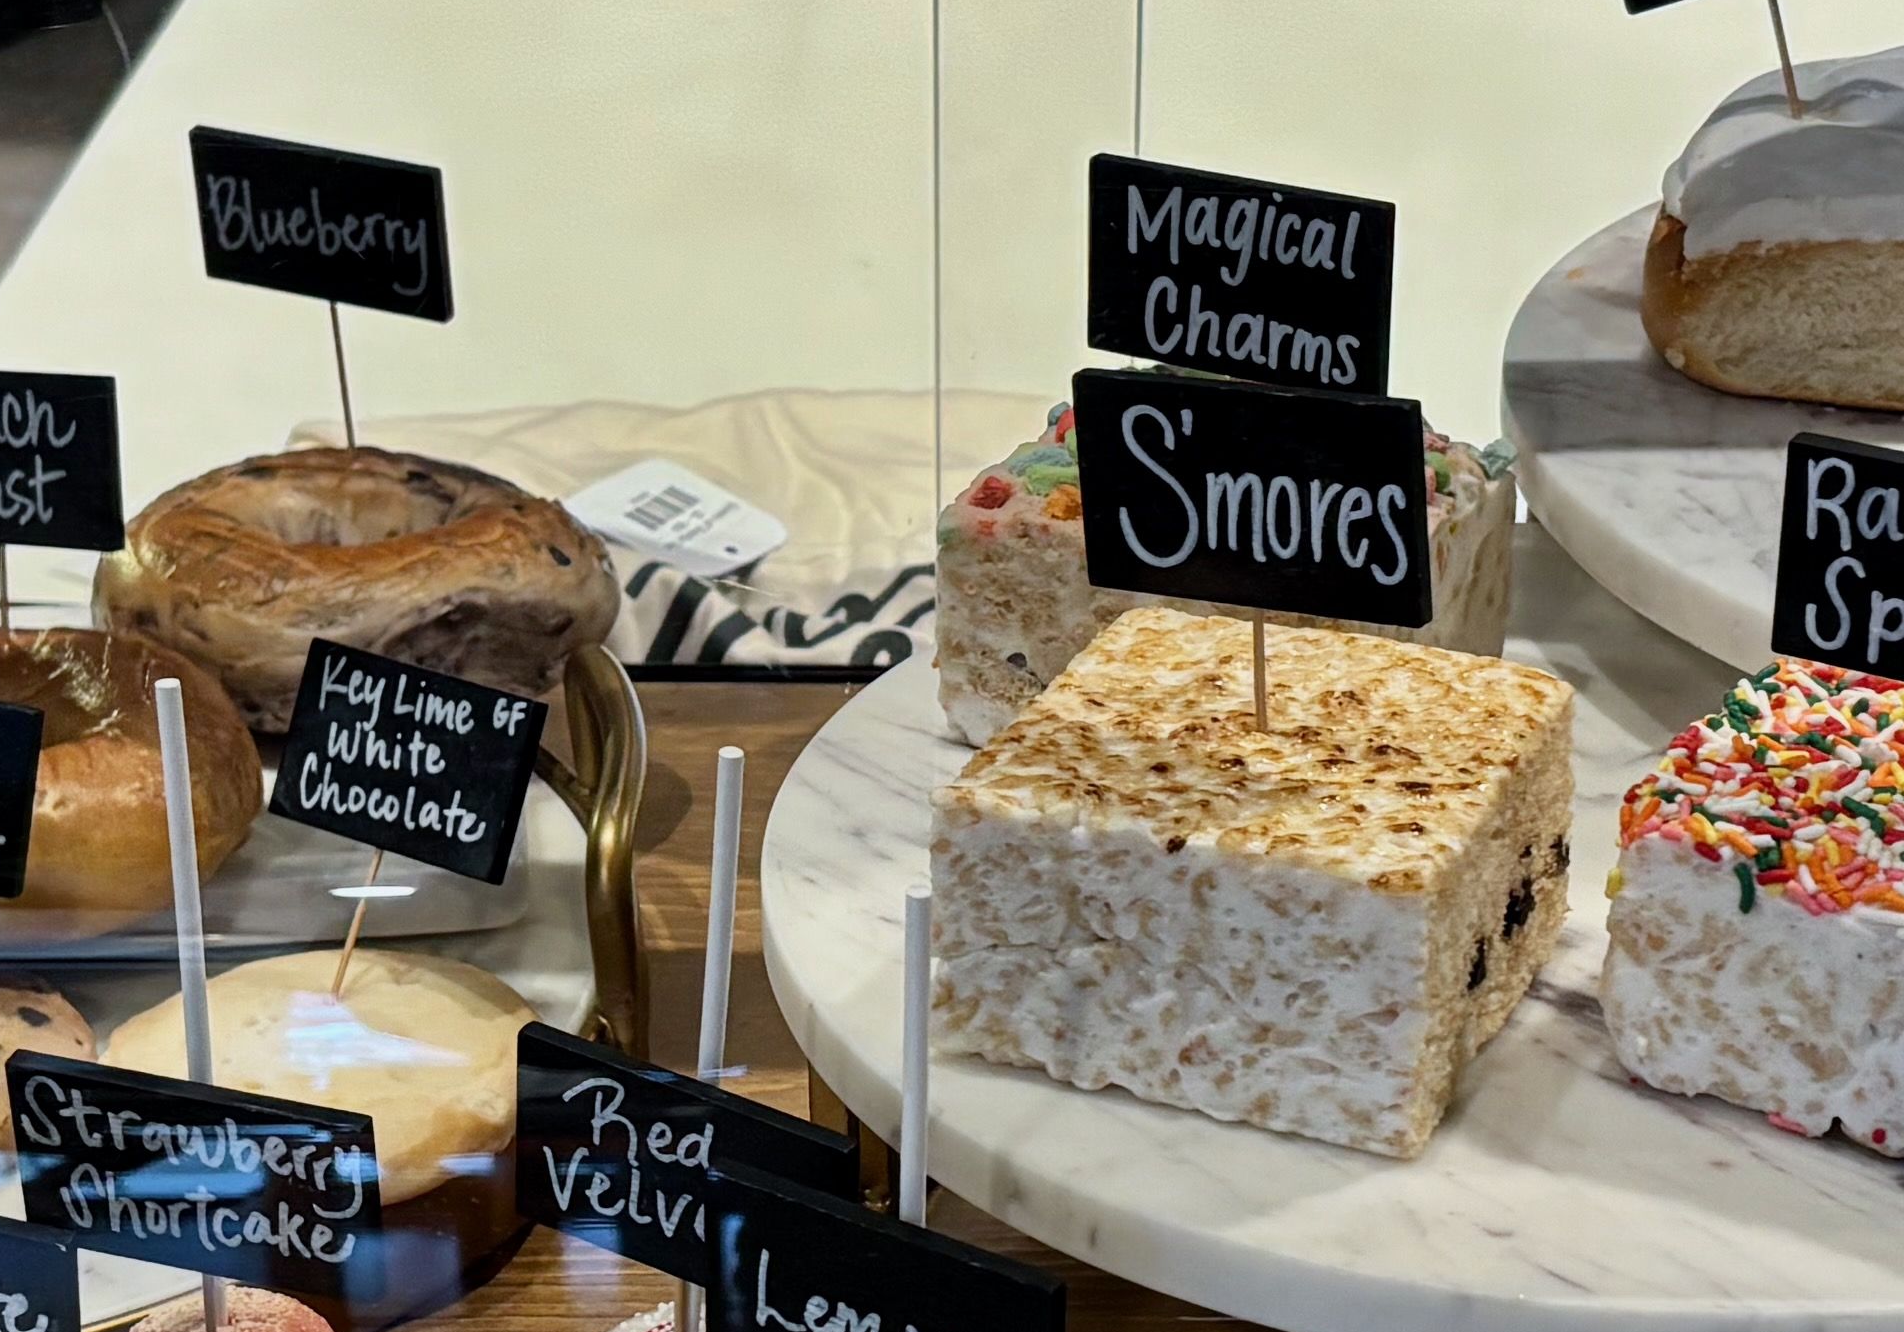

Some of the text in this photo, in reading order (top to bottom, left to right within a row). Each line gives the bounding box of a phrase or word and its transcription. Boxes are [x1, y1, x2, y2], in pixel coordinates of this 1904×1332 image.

[205, 172, 427, 296] Blueberry
[1127, 184, 1362, 287] Magical
[1144, 274, 1361, 386] Charms
[1118, 403, 1409, 586] S'mores
[319, 654, 528, 737] Key Lime GF
[298, 751, 487, 844] Chocolate
[328, 721, 446, 778] White
[18, 1075, 363, 1219] Strawberry
[562, 1076, 714, 1168] Red
[61, 1163, 356, 1266] Shortcake
[542, 1144, 705, 1244] Velv
